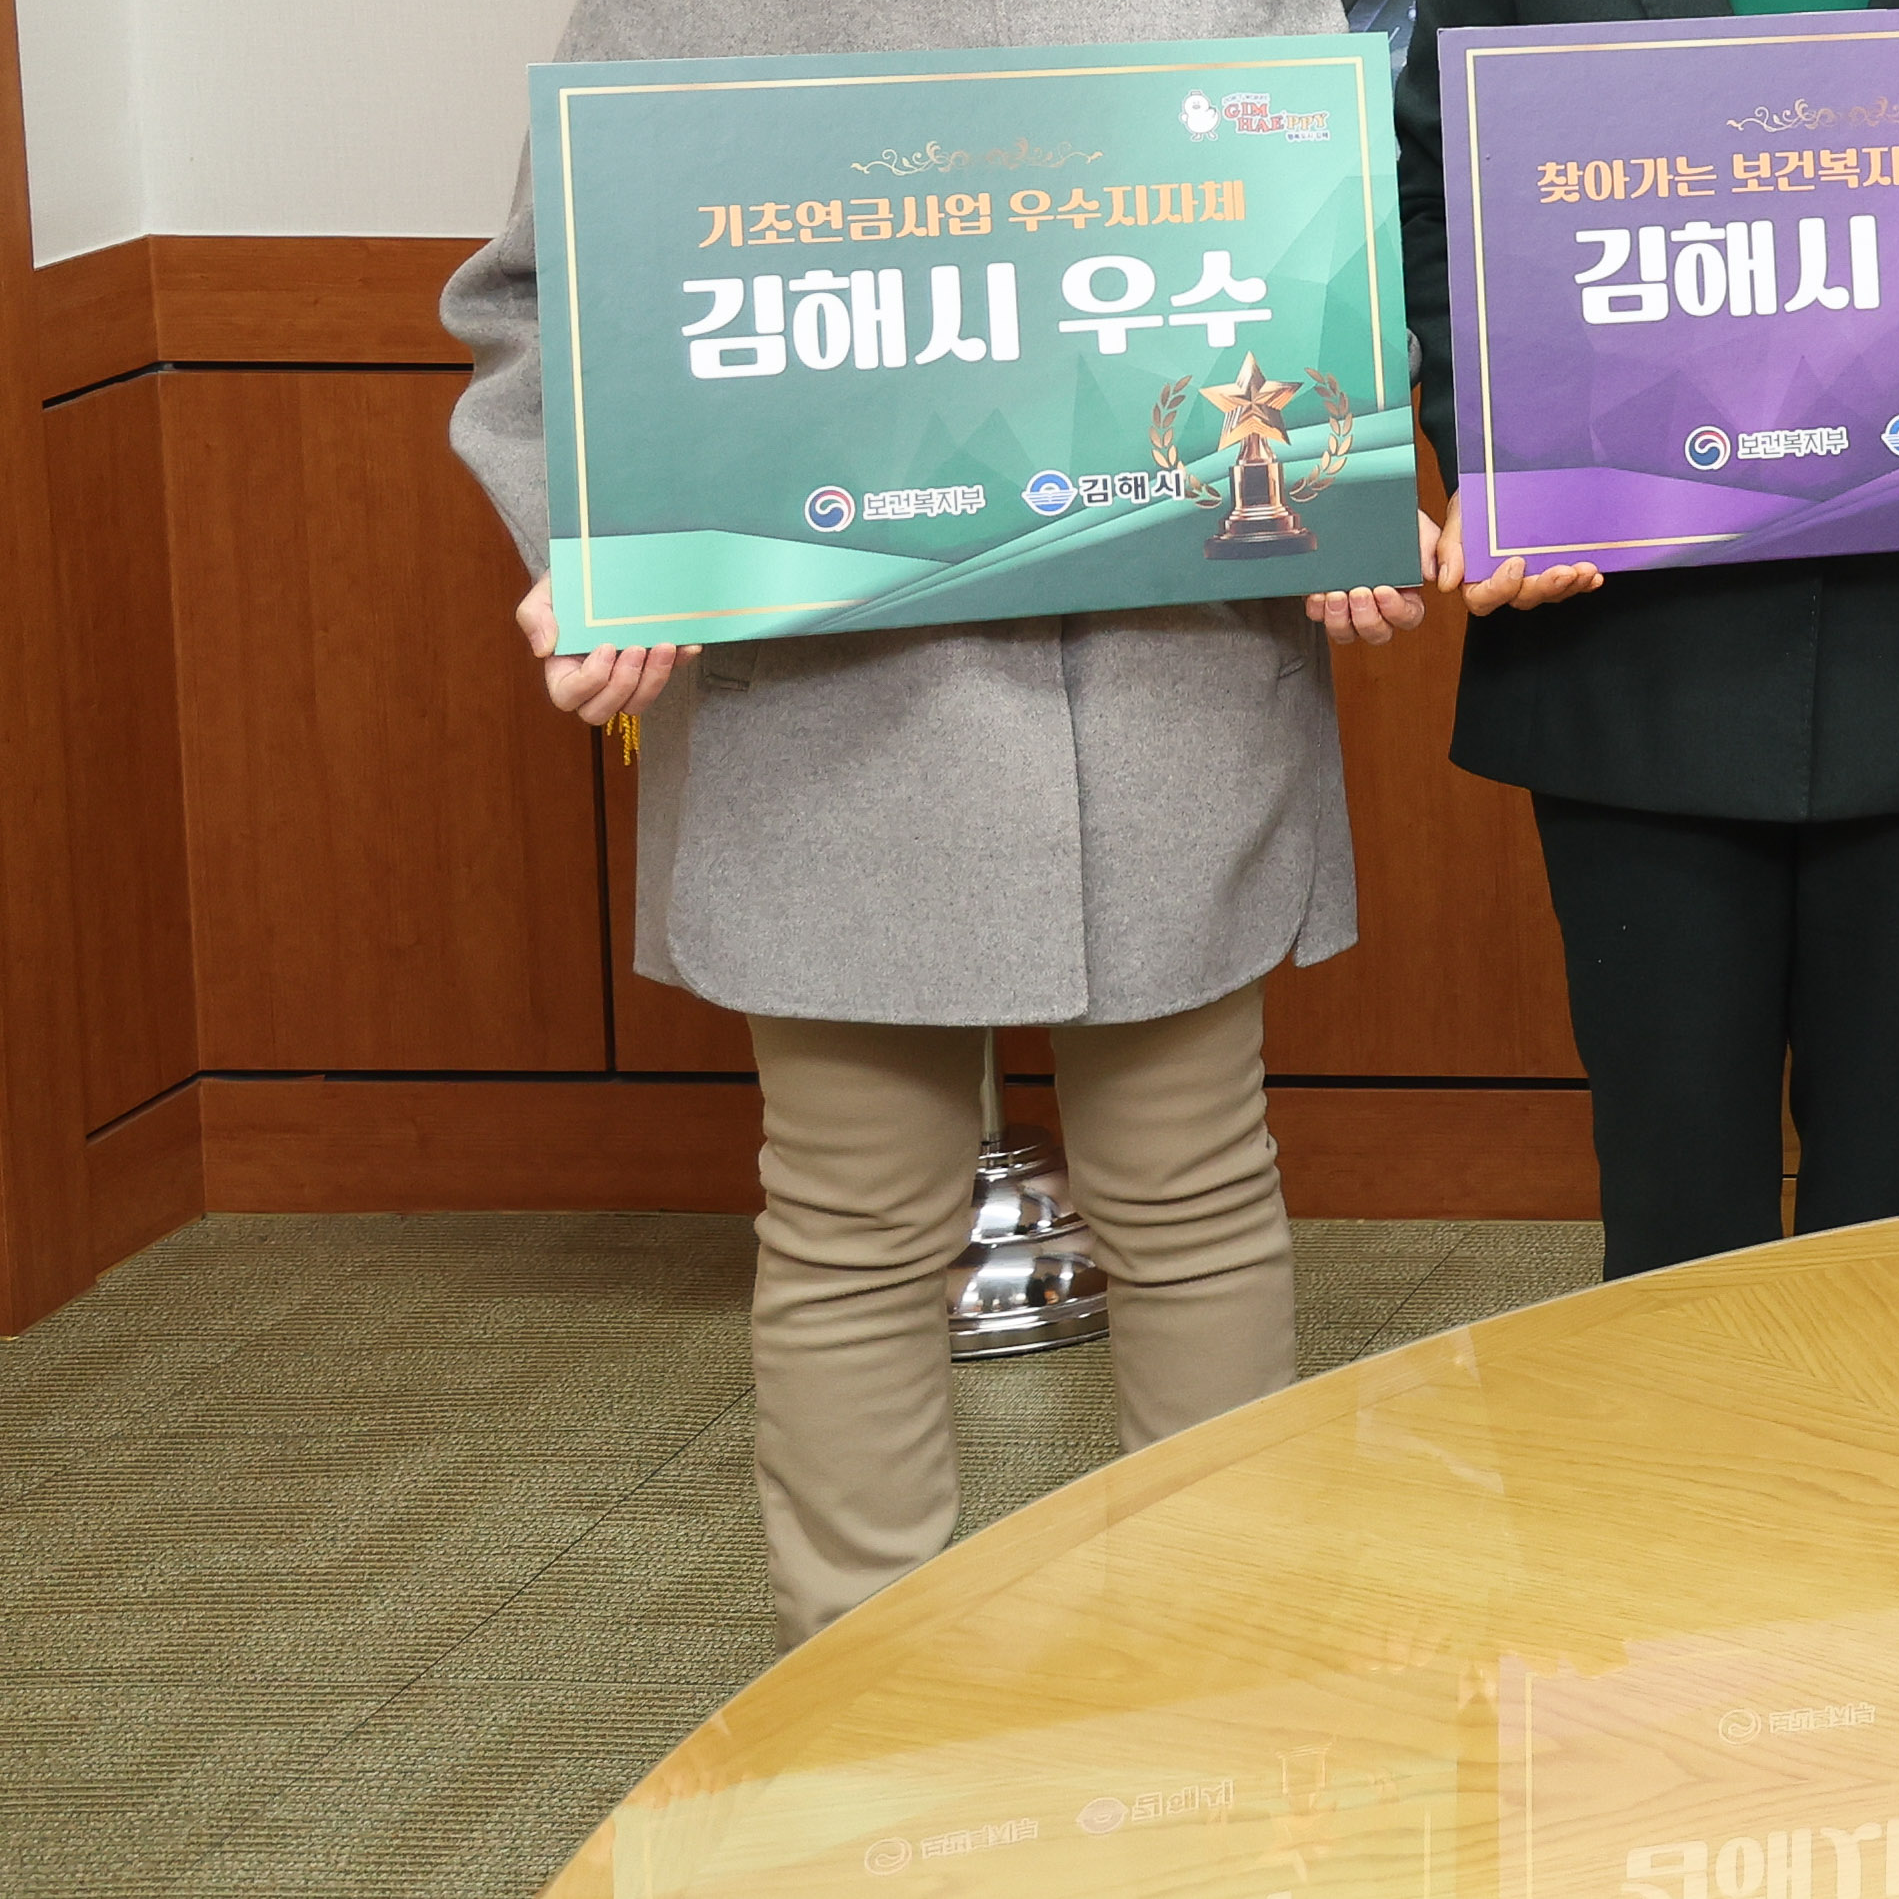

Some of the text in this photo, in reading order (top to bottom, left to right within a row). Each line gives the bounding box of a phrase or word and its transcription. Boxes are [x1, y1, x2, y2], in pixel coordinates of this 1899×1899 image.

[1535, 156, 1719, 206] 찾아가는
[695, 177, 1248, 251] 기초연금사업 우수지자체
[1572, 213, 1882, 326] 김해시
[679, 248, 1275, 381] 김해시 우수
[1736, 423, 1850, 462] 보건복지부
[862, 483, 987, 523] 보건복지부
[1078, 467, 1186, 505] 김해시
